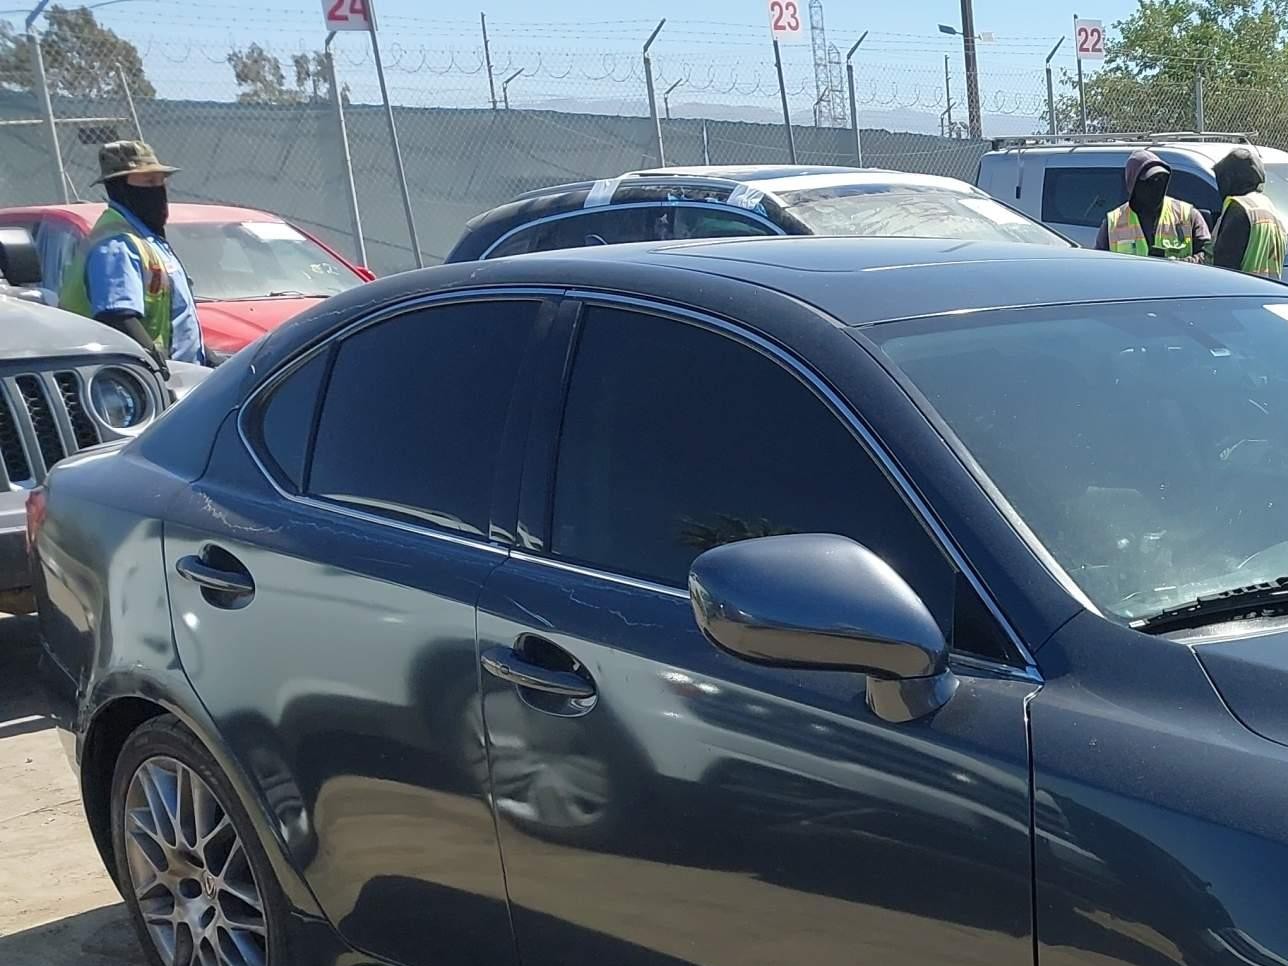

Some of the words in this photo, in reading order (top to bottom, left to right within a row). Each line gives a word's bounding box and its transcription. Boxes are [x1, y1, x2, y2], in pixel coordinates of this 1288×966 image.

[327, 0, 369, 22] 24
[770, 1, 799, 31] 23
[1078, 27, 1103, 52] 22
